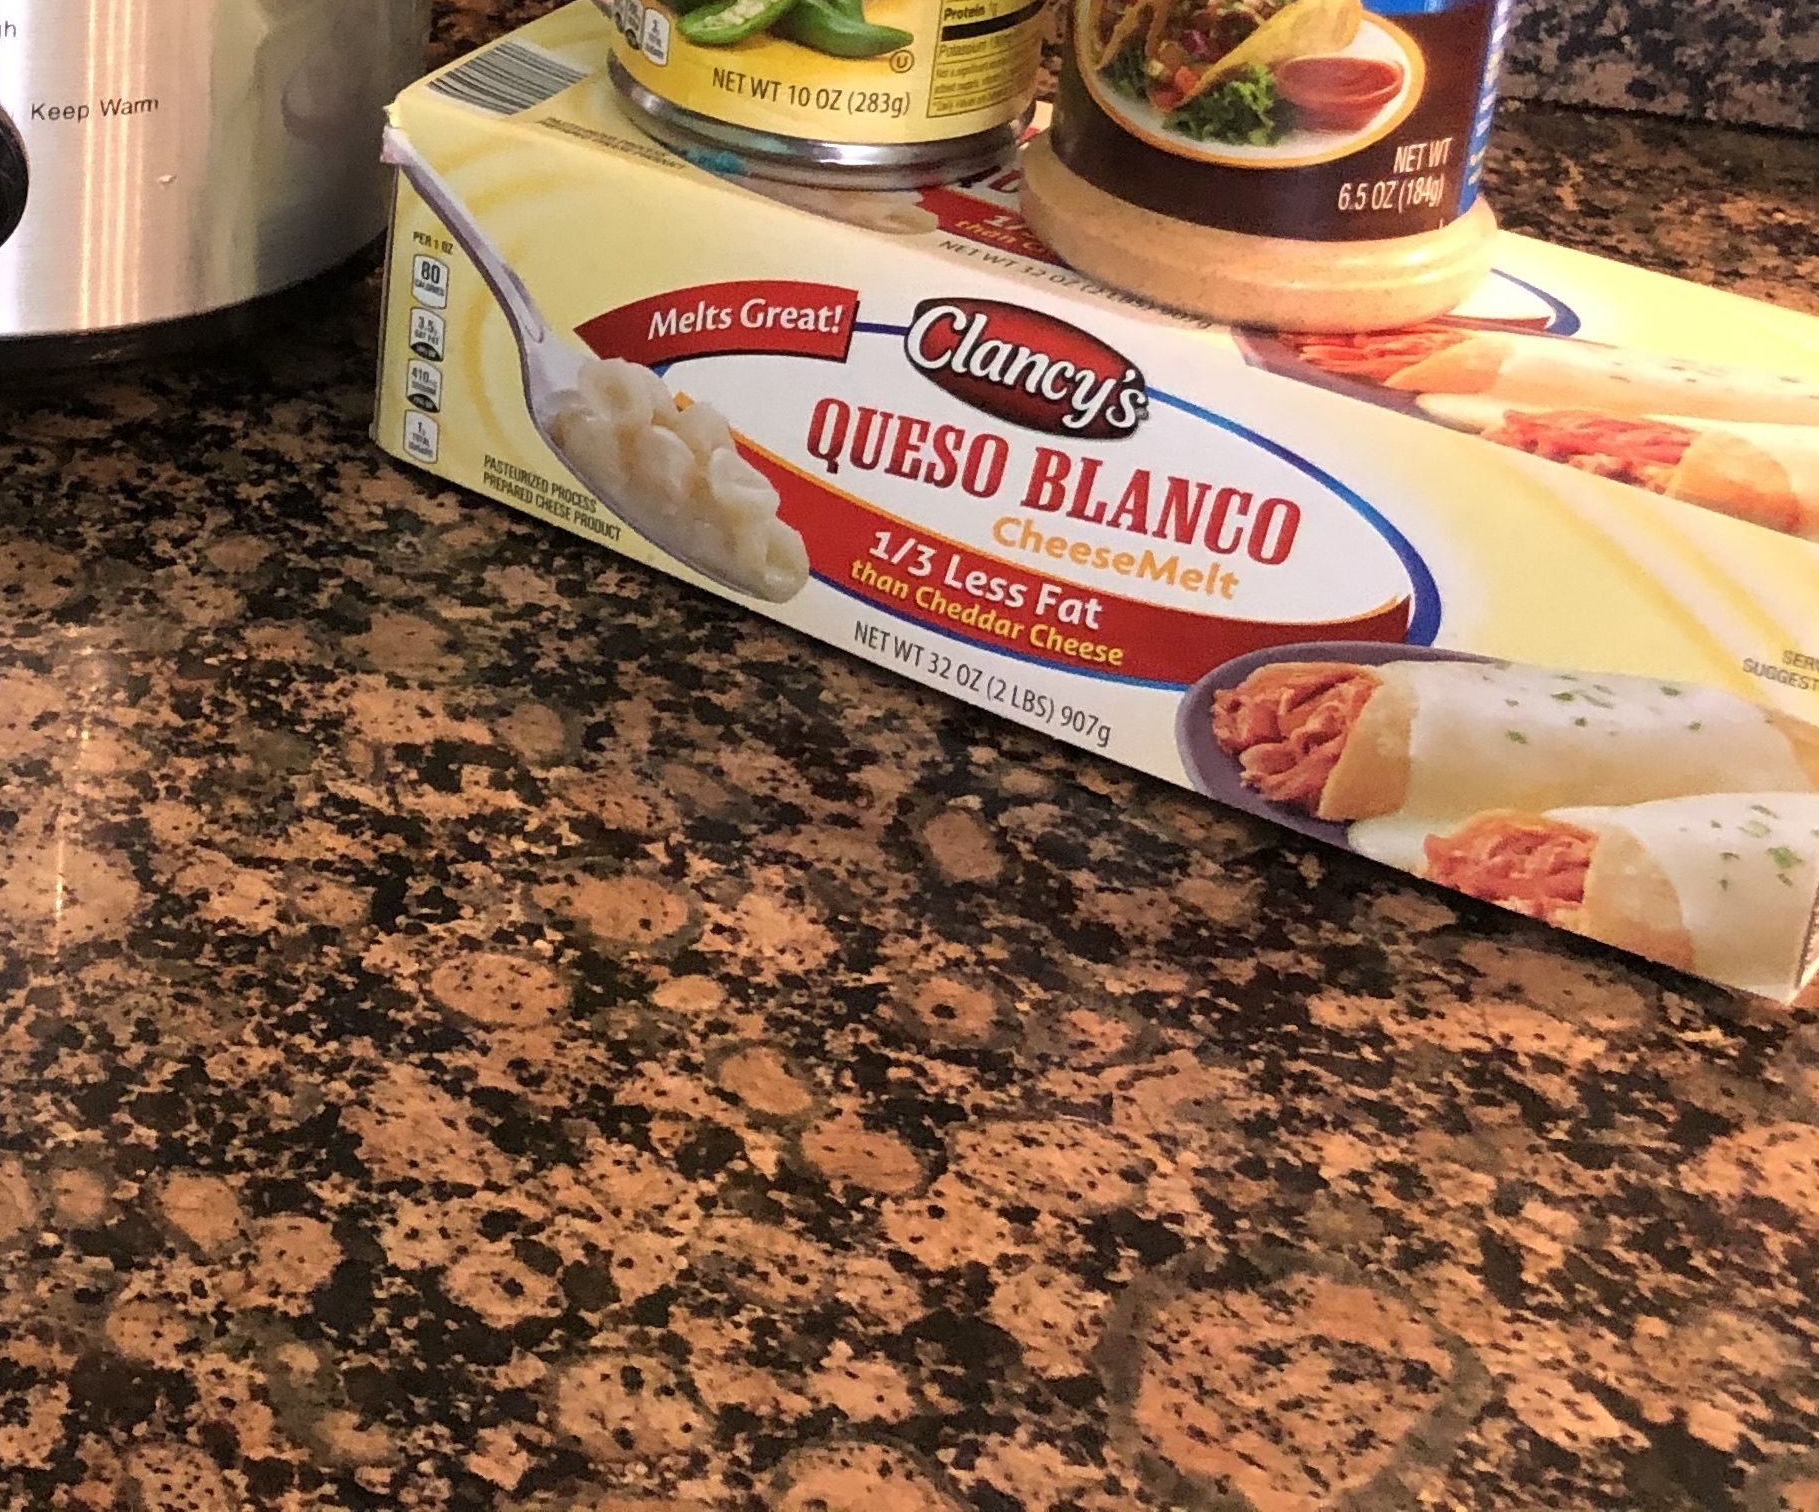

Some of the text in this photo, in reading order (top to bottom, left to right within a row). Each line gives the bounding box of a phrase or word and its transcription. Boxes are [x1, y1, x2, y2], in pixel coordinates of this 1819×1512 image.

[31, 97, 159, 123] Keep Warm
[712, 67, 746, 94] NET
[751, 76, 782, 102] WT
[788, 85, 812, 107] 10
[816, 88, 844, 111] OZ
[847, 91, 912, 118] (283g)
[1393, 137, 1453, 174] NET WT
[1338, 173, 1445, 214] 6.5 OZ (184g)
[421, 261, 441, 285] 80
[939, 239, 979, 257] NET
[982, 252, 1019, 268] WT
[648, 297, 843, 340] Melts Great!
[909, 302, 1150, 432] Clancy's
[483, 471, 622, 542] PREPARED CHEESE PRODUCT
[484, 454, 597, 514] PASTEURIZED PROCESS
[806, 397, 1303, 567] QUESO BLANCO
[869, 530, 1103, 630] 1/3 Less Fat
[991, 514, 1241, 602] CheeseMelt
[850, 558, 1125, 666] than Cheddar Cheese
[853, 620, 1112, 749] NET WT 32 OZ (2 LBS) 907g
